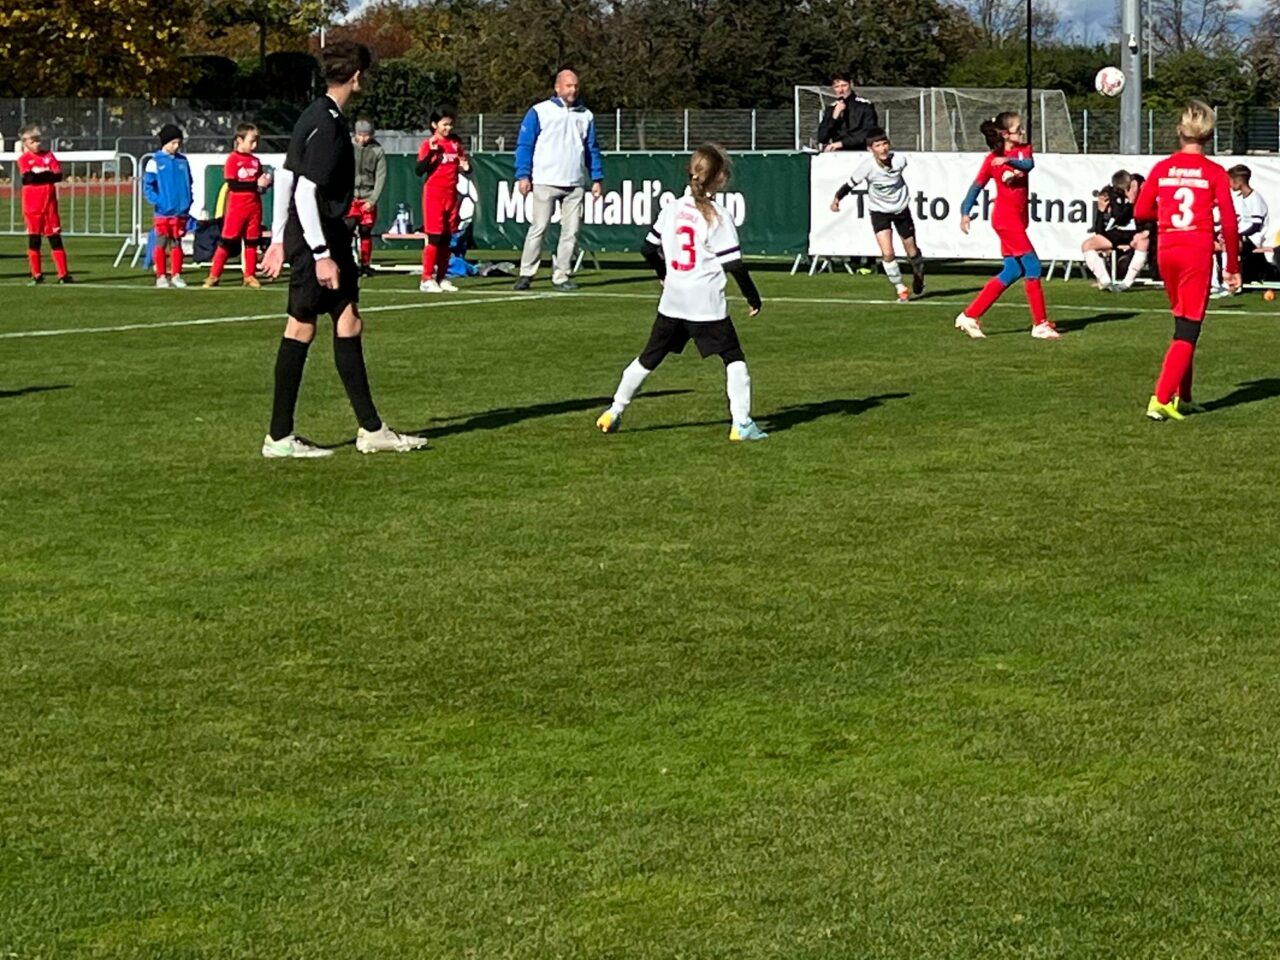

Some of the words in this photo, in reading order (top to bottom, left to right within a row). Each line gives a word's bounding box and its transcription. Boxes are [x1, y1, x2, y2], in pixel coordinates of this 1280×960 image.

[496, 180, 676, 226] Mcnald'
[850, 189, 950, 221] Tto
[1171, 187, 1195, 229] 3
[672, 226, 696, 271] 3
